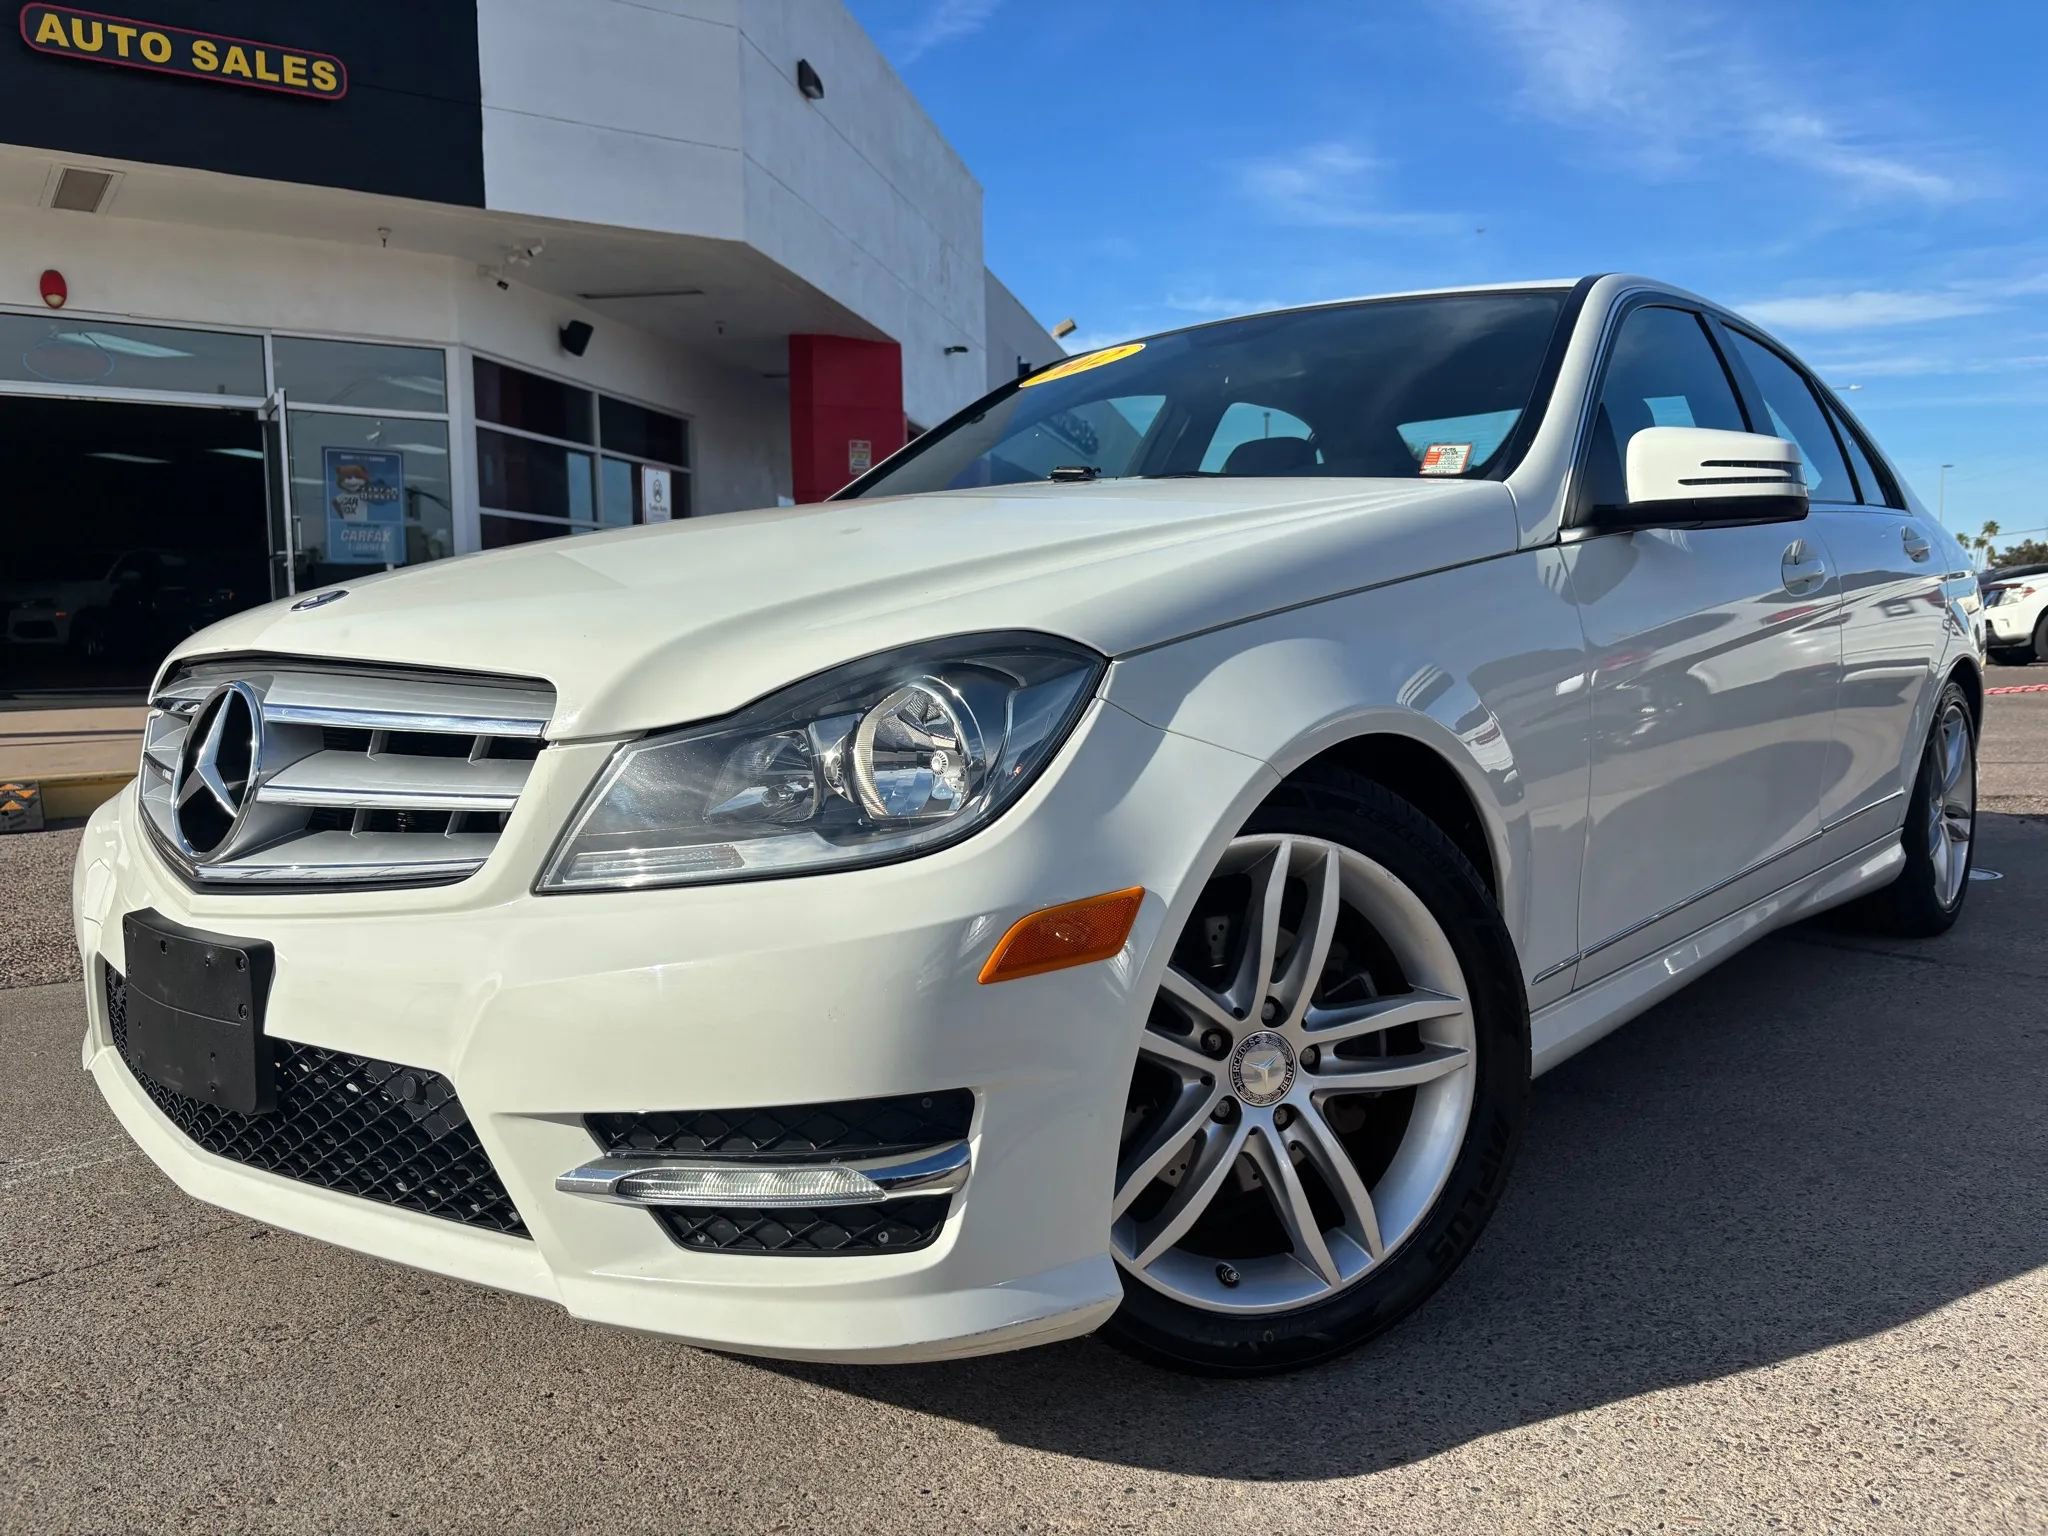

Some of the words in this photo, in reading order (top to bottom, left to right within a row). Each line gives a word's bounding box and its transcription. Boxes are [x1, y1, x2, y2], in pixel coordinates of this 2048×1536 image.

[35, 12, 172, 63] AUTO
[192, 40, 338, 91] SALES
[340, 529, 392, 543] CARFAX
[1232, 1037, 1257, 1089] MERCEDES
[1280, 1063, 1294, 1092] BENZ
